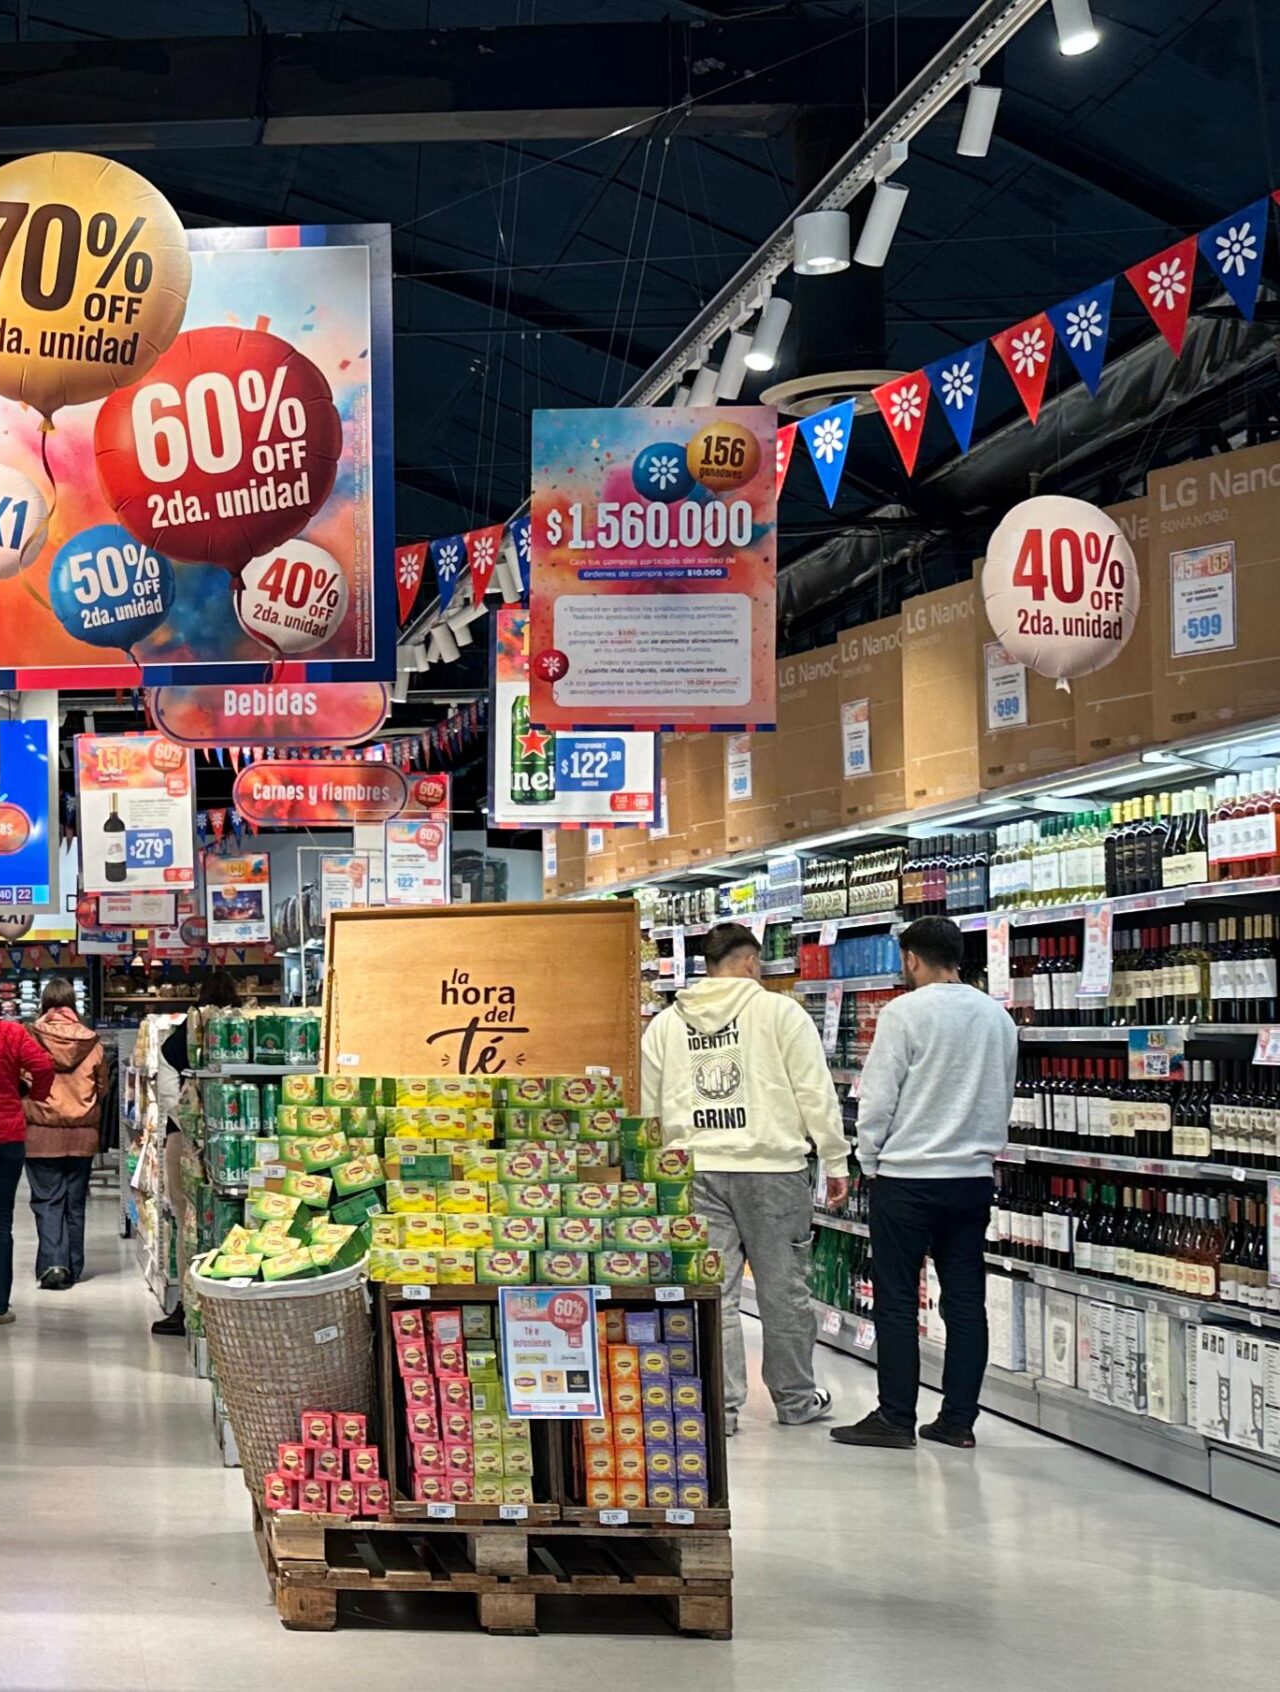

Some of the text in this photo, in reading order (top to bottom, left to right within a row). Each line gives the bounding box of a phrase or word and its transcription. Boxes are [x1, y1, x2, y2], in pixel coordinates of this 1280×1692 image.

[83, 291, 142, 325] OFF
[40, 326, 138, 366] unidad
[131, 367, 307, 484] 60%
[252, 440, 307, 475] OFF
[700, 435, 746, 468] 156
[698, 468, 742, 480] ganadores
[148, 472, 310, 529] 2da. unidad
[1160, 478, 1198, 512] LG
[69, 544, 160, 604] 50%
[631, 570, 662, 578] compra
[664, 569, 684, 577] valor
[687, 569, 722, 577] $10.000
[1013, 528, 1124, 605] 40%
[133, 578, 160, 596] OFF
[257, 558, 339, 609] 40%
[80, 598, 163, 629] 2da. unidad
[308, 604, 334, 623] OFF
[1090, 592, 1123, 612] OFF
[253, 603, 329, 639] 2da. unidad
[906, 609, 926, 634] LG
[1018, 609, 1121, 641] 2da. unidad
[1188, 613, 1222, 639] 599
[841, 640, 858, 663] LG
[779, 665, 795, 688] LG
[224, 688, 318, 717] Bebidas
[154, 743, 182, 760] 60%
[252, 781, 390, 805] Carnes y fiambres
[18, 889, 31, 899] 22
[451, 969, 469, 985] la
[441, 981, 515, 1005] hora
[485, 1006, 515, 1023] del
[688, 1031, 739, 1050] IDENTITY
[693, 1107, 747, 1129] GRIND
[554, 1298, 584, 1316] 60%
